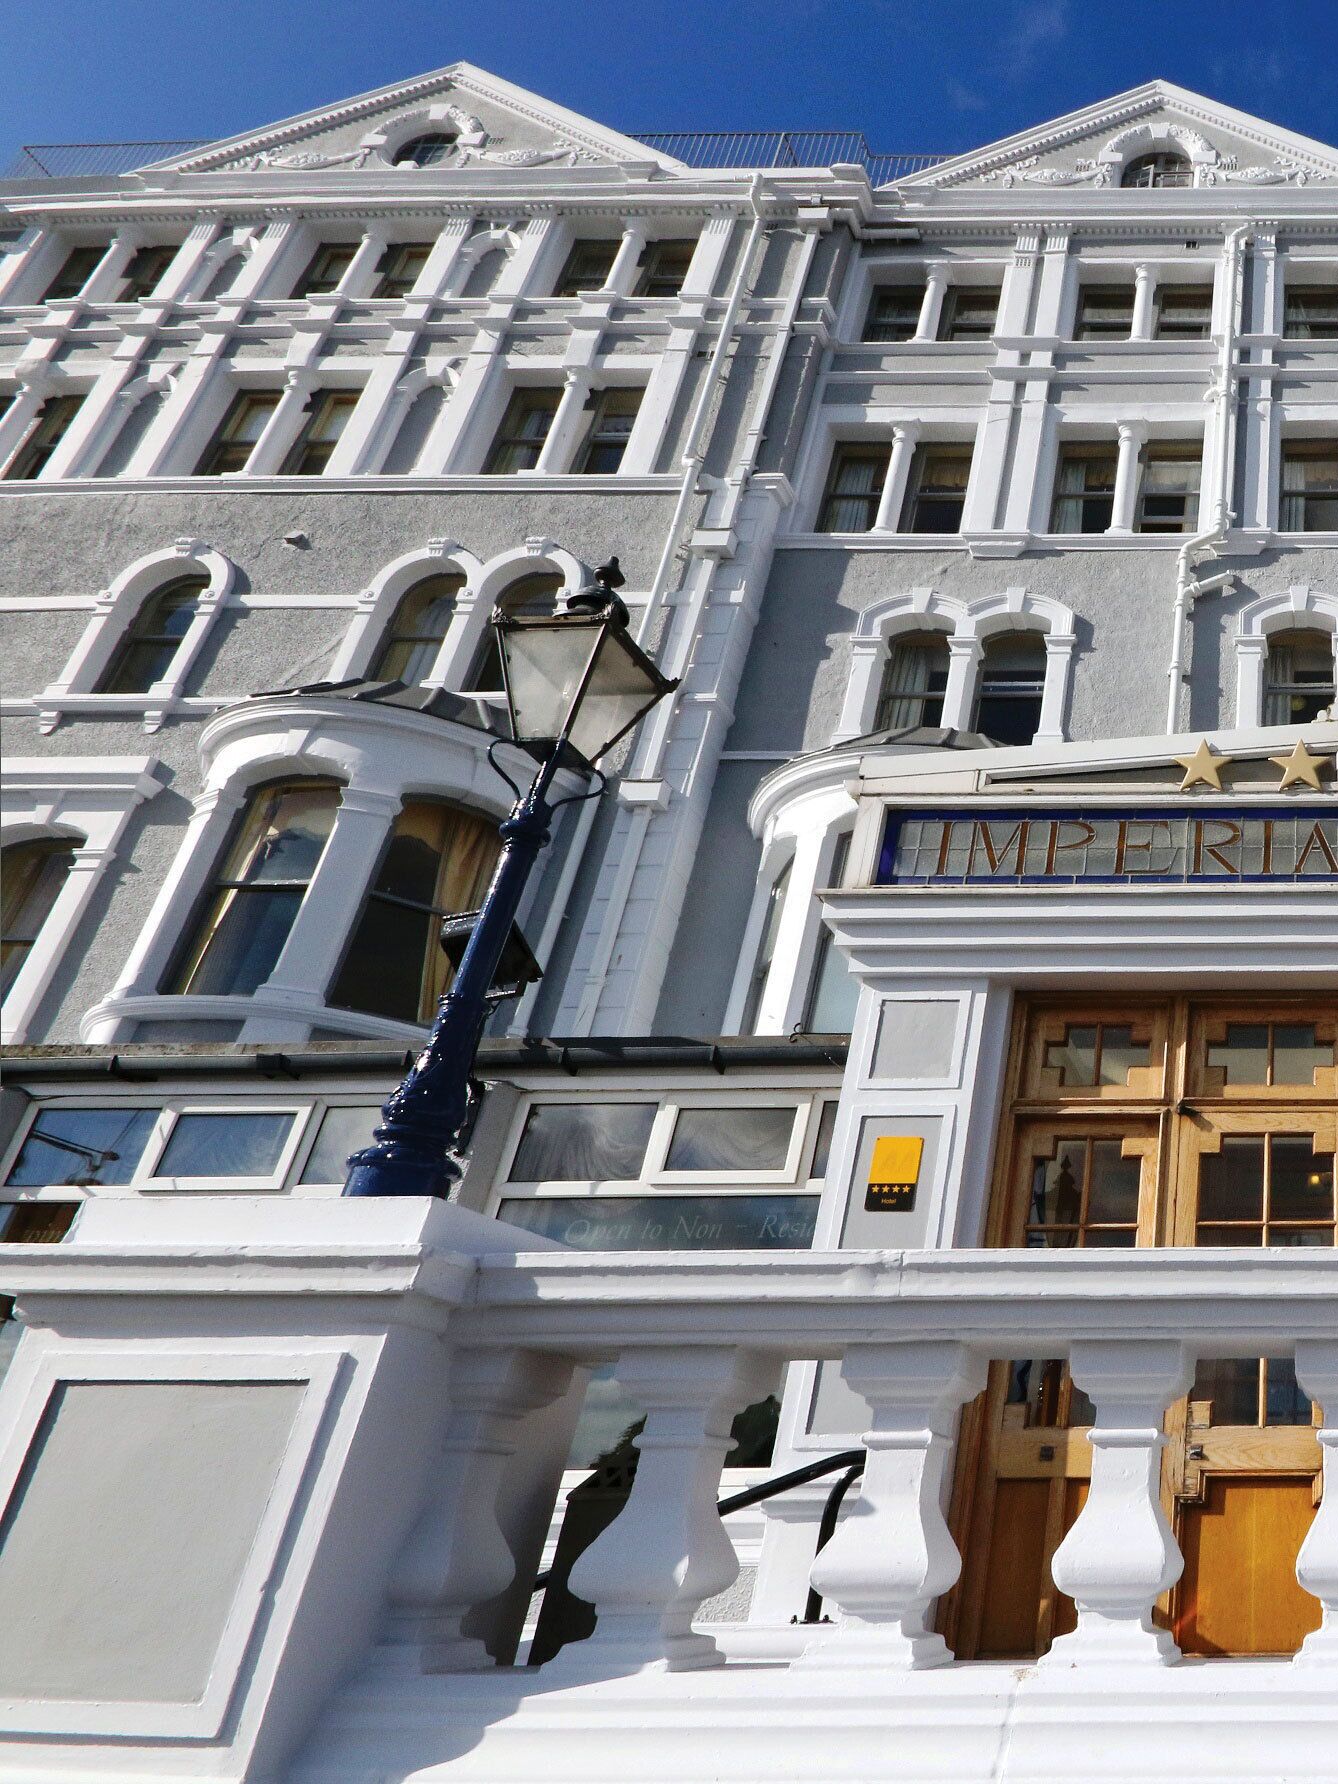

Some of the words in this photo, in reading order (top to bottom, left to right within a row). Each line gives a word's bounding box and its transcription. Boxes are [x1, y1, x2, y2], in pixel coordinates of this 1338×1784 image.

[565, 1219, 633, 1246] Open
[641, 1216, 663, 1240] to
[673, 1215, 724, 1239] Non
